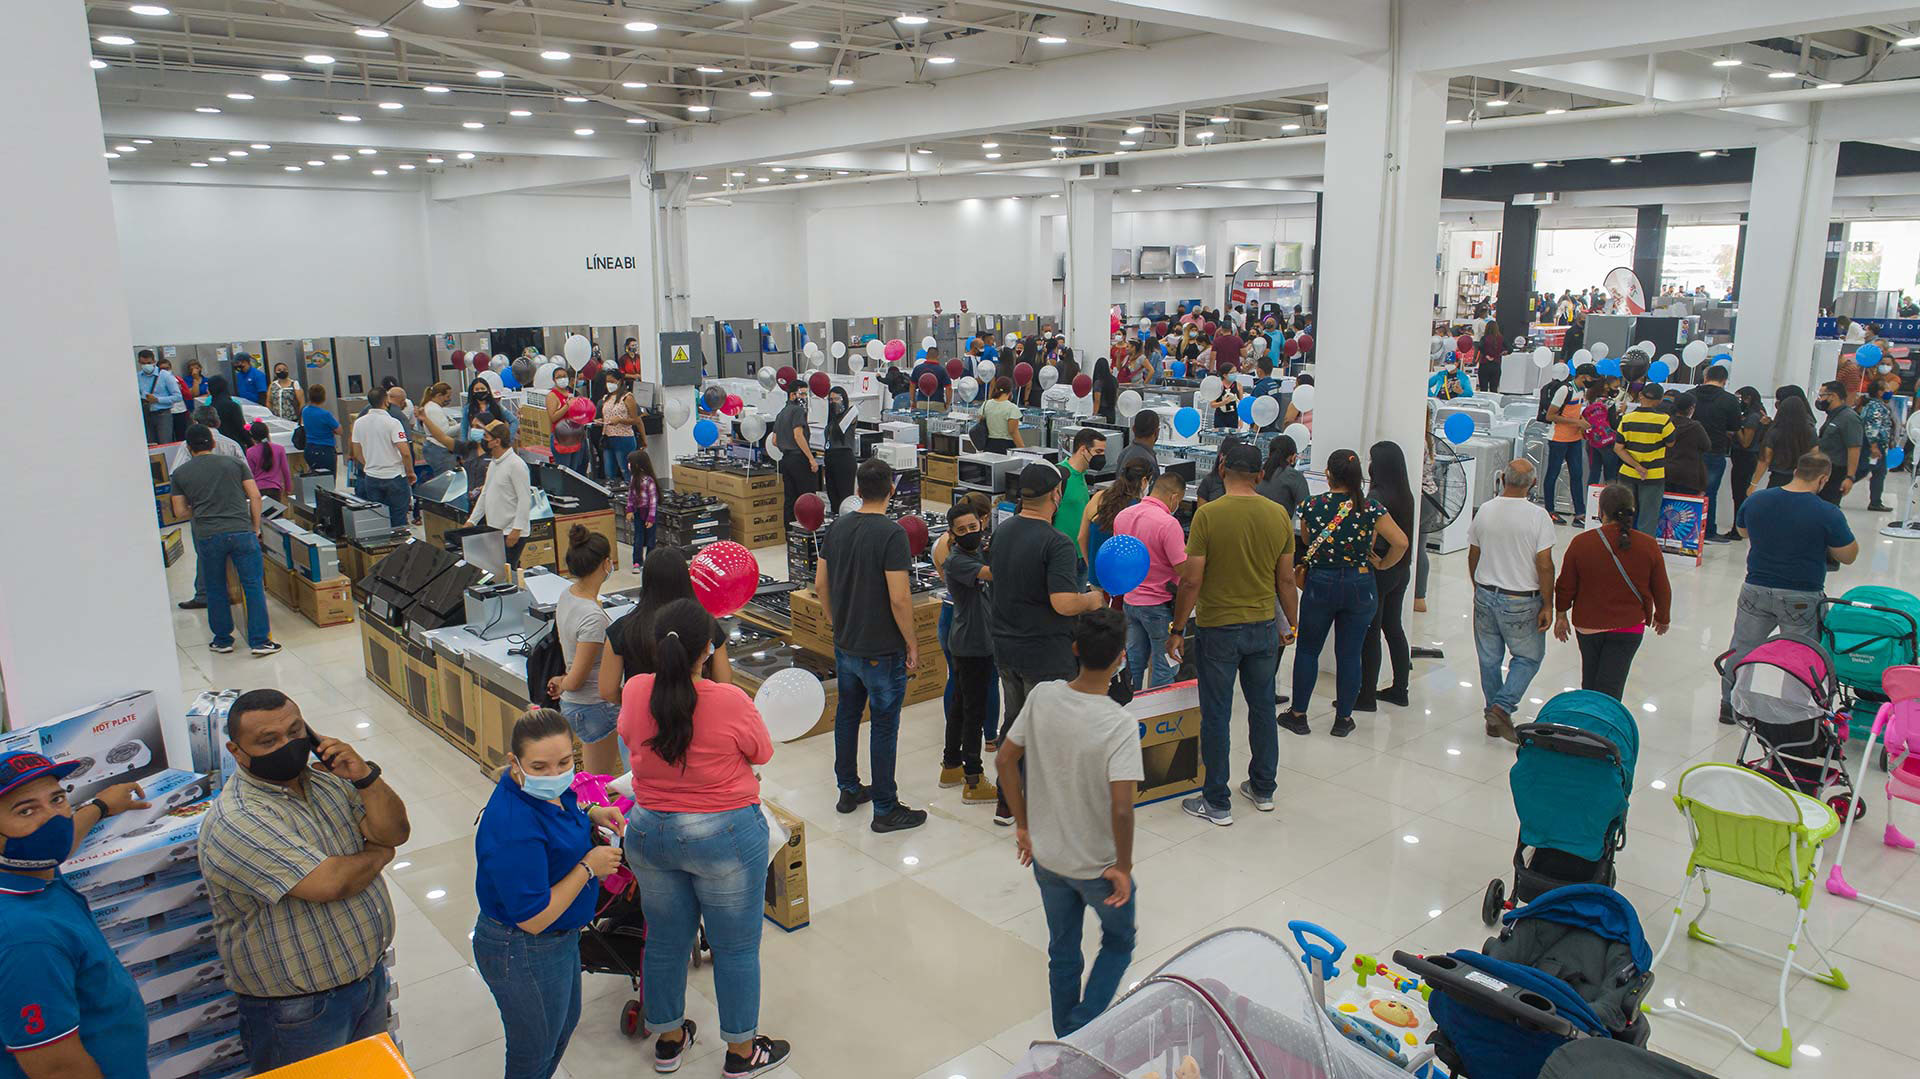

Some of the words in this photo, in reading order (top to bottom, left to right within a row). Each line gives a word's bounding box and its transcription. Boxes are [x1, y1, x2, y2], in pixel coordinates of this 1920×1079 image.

[92, 721, 110, 735] HOT
[112, 713, 137, 728] PLATE
[20, 1003, 46, 1035] 3
